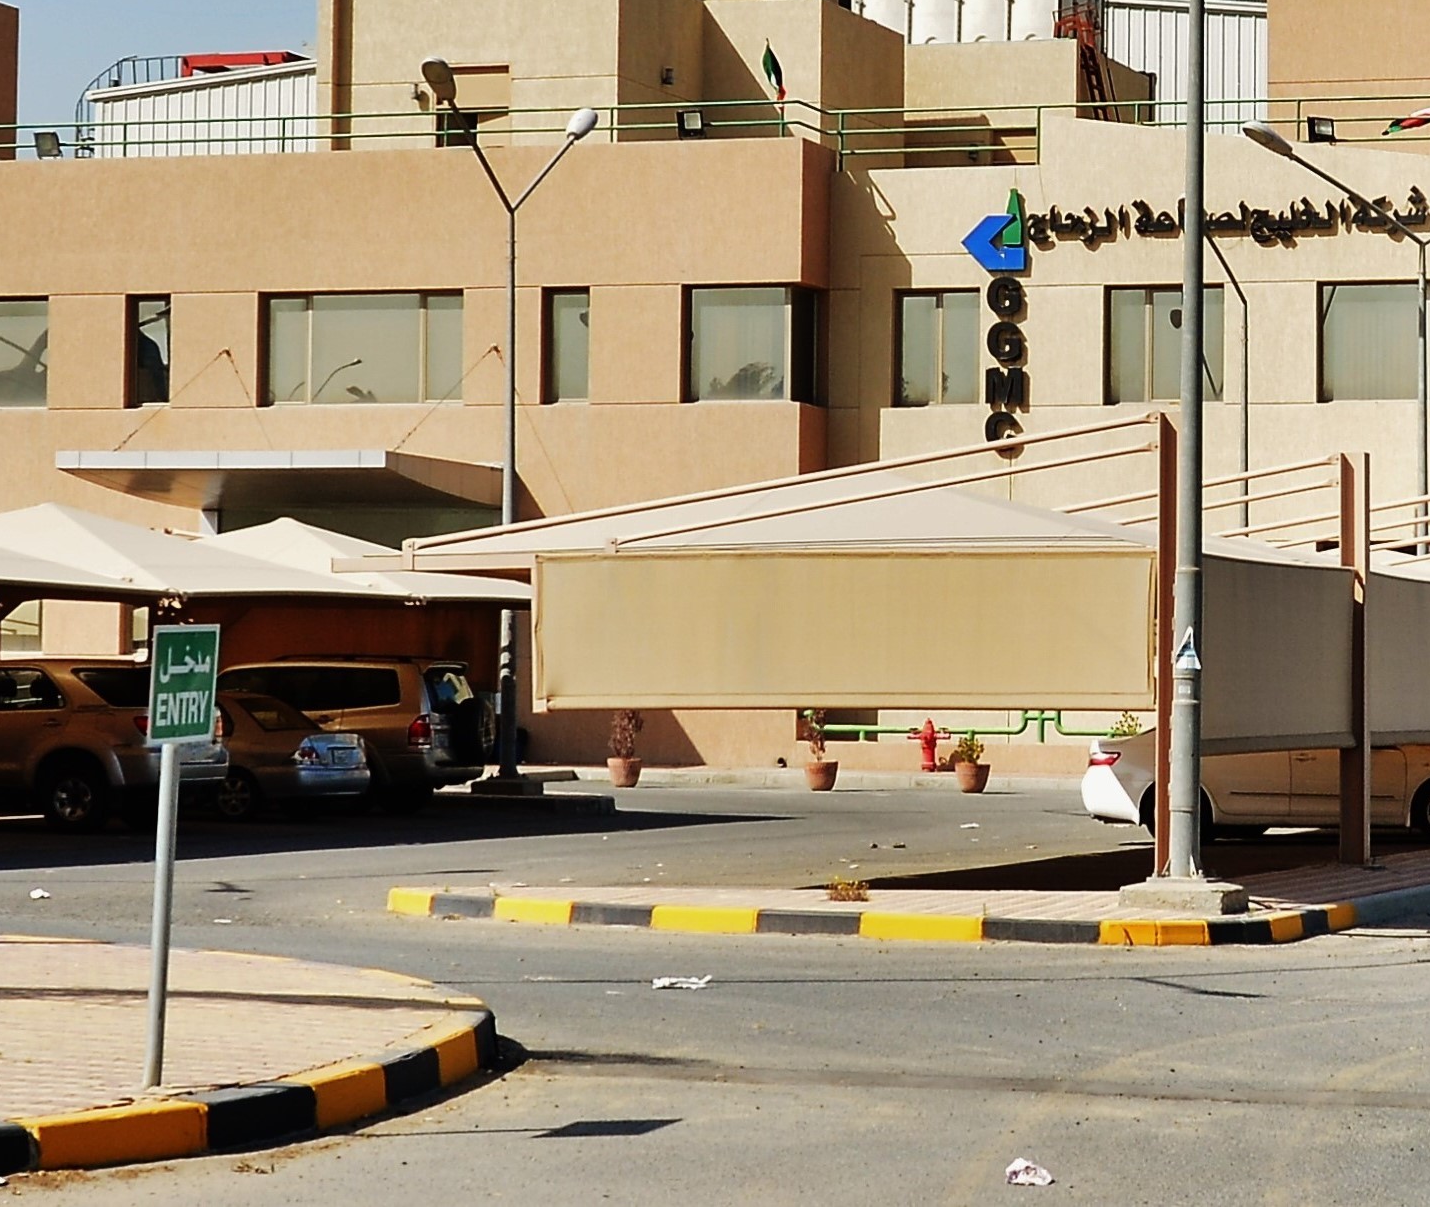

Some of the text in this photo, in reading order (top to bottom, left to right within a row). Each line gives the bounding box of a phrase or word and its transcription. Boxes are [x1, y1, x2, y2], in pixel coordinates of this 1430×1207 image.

[1132, 198, 1246, 232] لصاعة
[159, 645, 212, 684] مدخل
[156, 690, 209, 727] ENTRY
